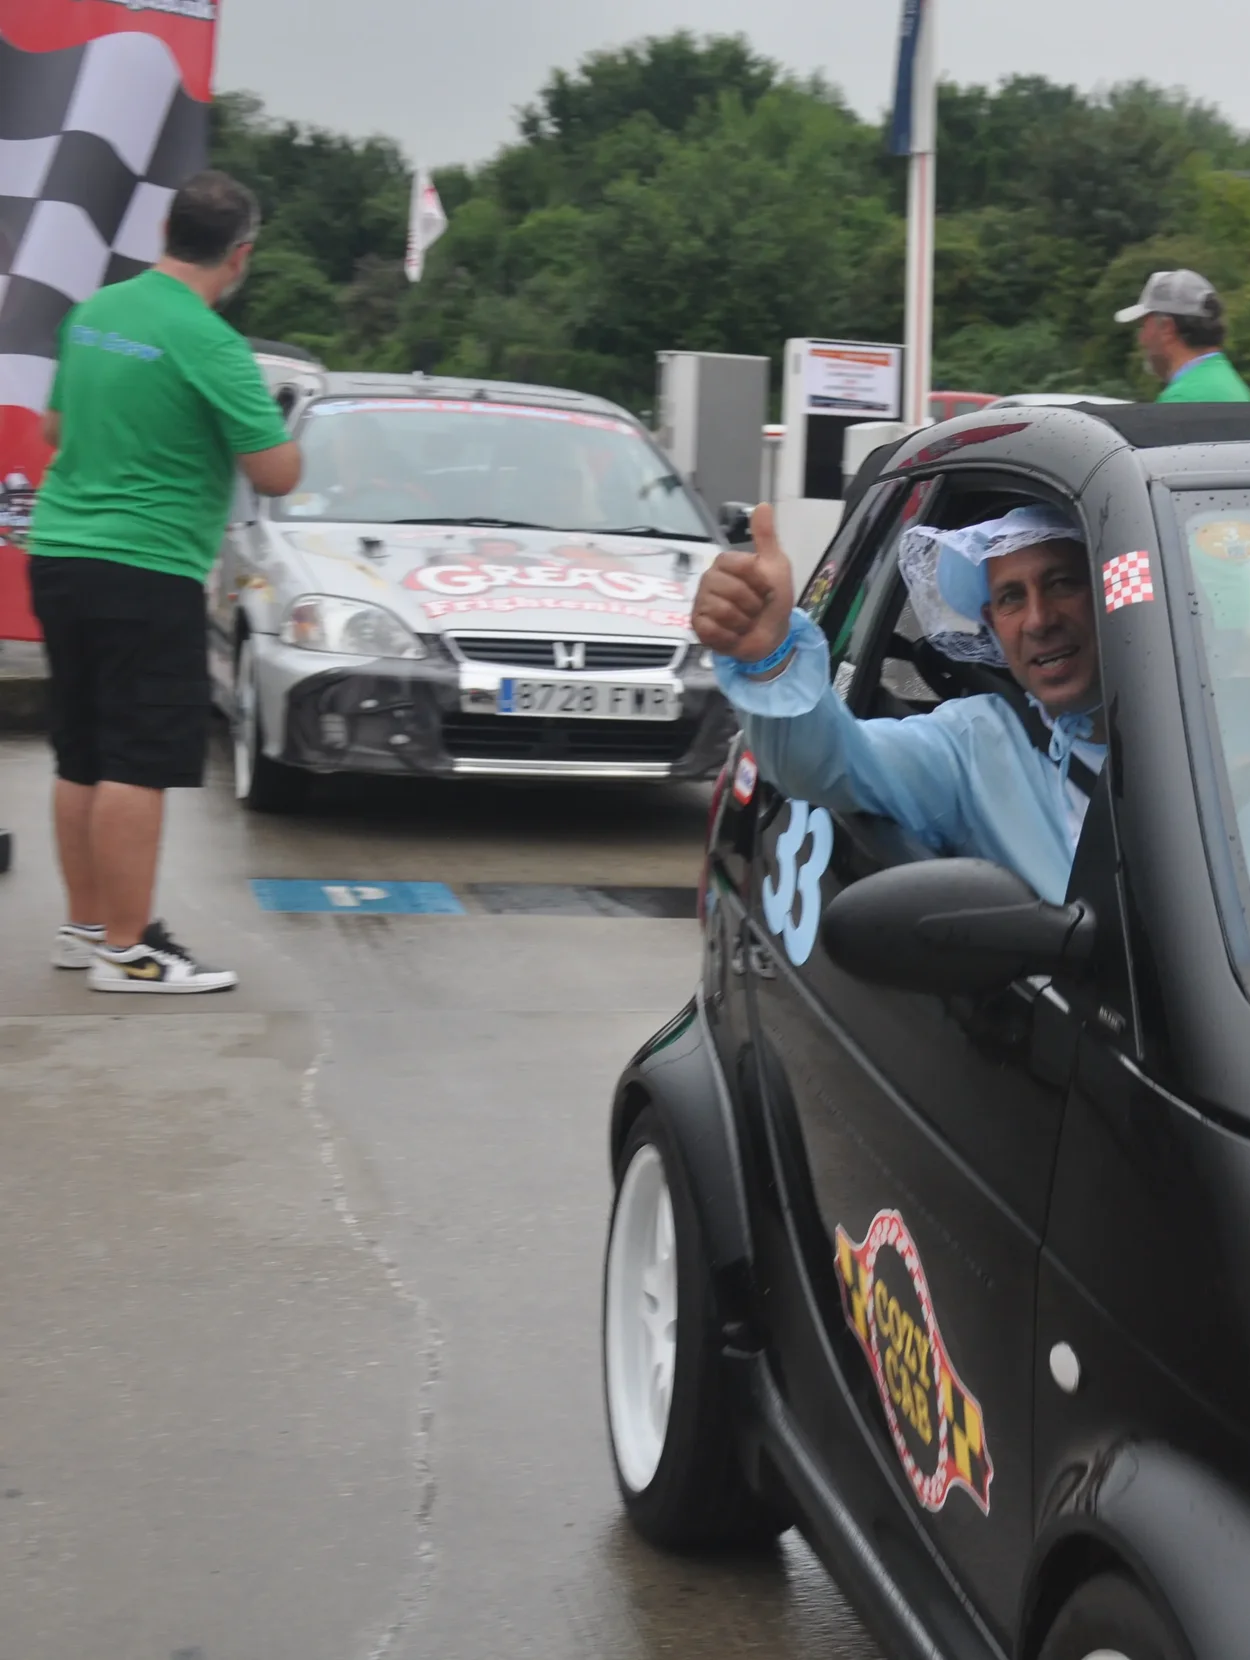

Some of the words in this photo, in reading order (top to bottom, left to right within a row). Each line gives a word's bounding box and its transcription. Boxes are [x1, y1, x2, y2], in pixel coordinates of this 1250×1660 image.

[516, 682, 600, 713] 8728
[762, 799, 834, 967] 33
[873, 1278, 930, 1391] COZY
[884, 1345, 932, 1446] CAB
